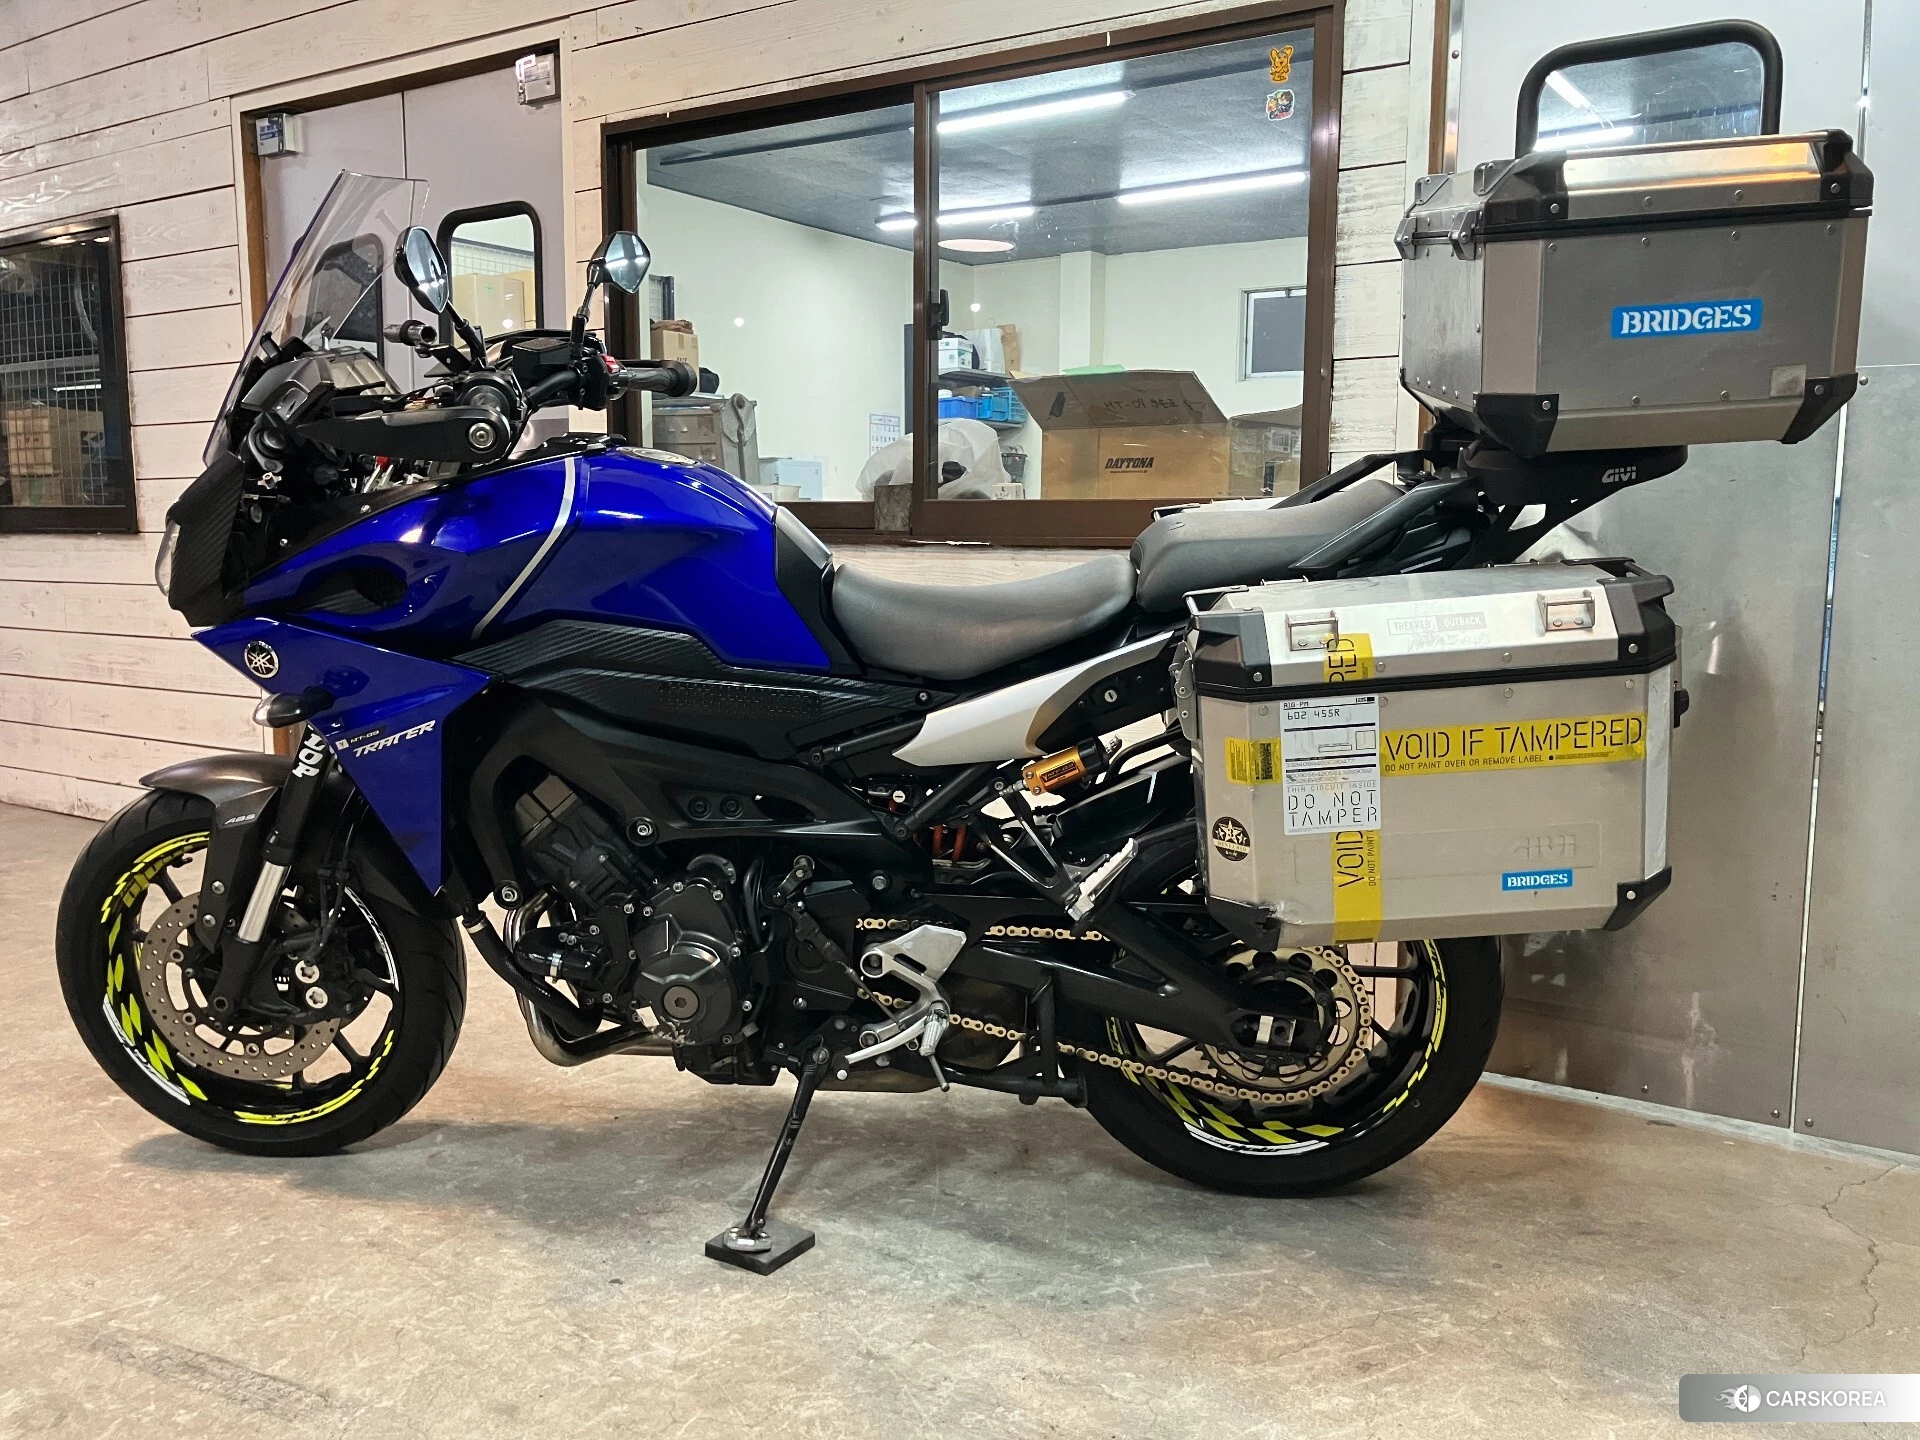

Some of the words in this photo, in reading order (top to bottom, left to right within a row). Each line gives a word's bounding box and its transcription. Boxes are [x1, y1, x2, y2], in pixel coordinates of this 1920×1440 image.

[1621, 304, 1752, 334] BRIDGES
[1105, 457, 1154, 469] DAYTONA
[1601, 465, 1637, 484] GIVI
[1443, 615, 1482, 627] OUTBACK
[1384, 731, 1450, 761] VOID
[1462, 728, 1484, 756] IF
[1494, 717, 1642, 754] TAMPERED
[1384, 763, 1396, 772] DO
[1398, 762, 1415, 771] NOT
[1418, 760, 1442, 769] PAINT
[1444, 759, 1466, 768] OVER
[1468, 758, 1480, 767] OR
[1483, 755, 1515, 765] REMOVE
[1518, 754, 1544, 763] LABEL
[1310, 783, 1344, 792] CIRCUIT
[1349, 780, 1377, 789] INSIDE
[1288, 793, 1315, 811] DO
[1333, 789, 1377, 808] NOT
[1288, 806, 1377, 827] TAMPER
[1366, 835, 1375, 857] PAINT
[1335, 830, 1365, 888] VOID
[1366, 860, 1376, 874] NOT
[1368, 876, 1377, 887] DO
[1507, 873, 1569, 887] BRIDGES
